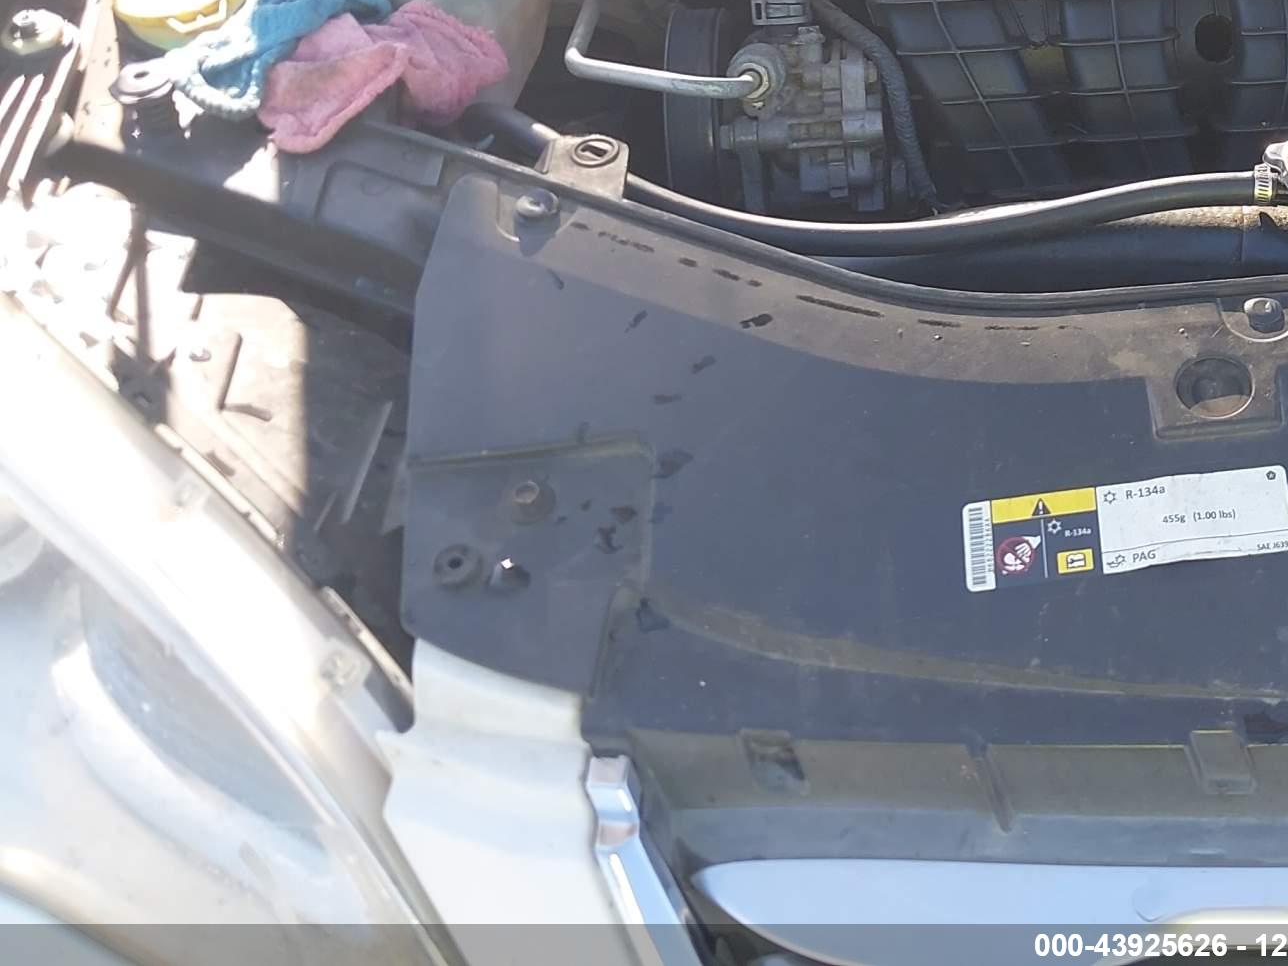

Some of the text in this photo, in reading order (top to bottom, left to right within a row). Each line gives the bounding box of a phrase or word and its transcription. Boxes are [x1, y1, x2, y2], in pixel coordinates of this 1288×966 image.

[1126, 485, 1166, 500] R-134a
[1162, 509, 1236, 524] 455g (1.00 lbs)
[1064, 527, 1092, 537] R-134a
[1257, 543, 1271, 551] SAE
[1132, 549, 1157, 563] PAG
